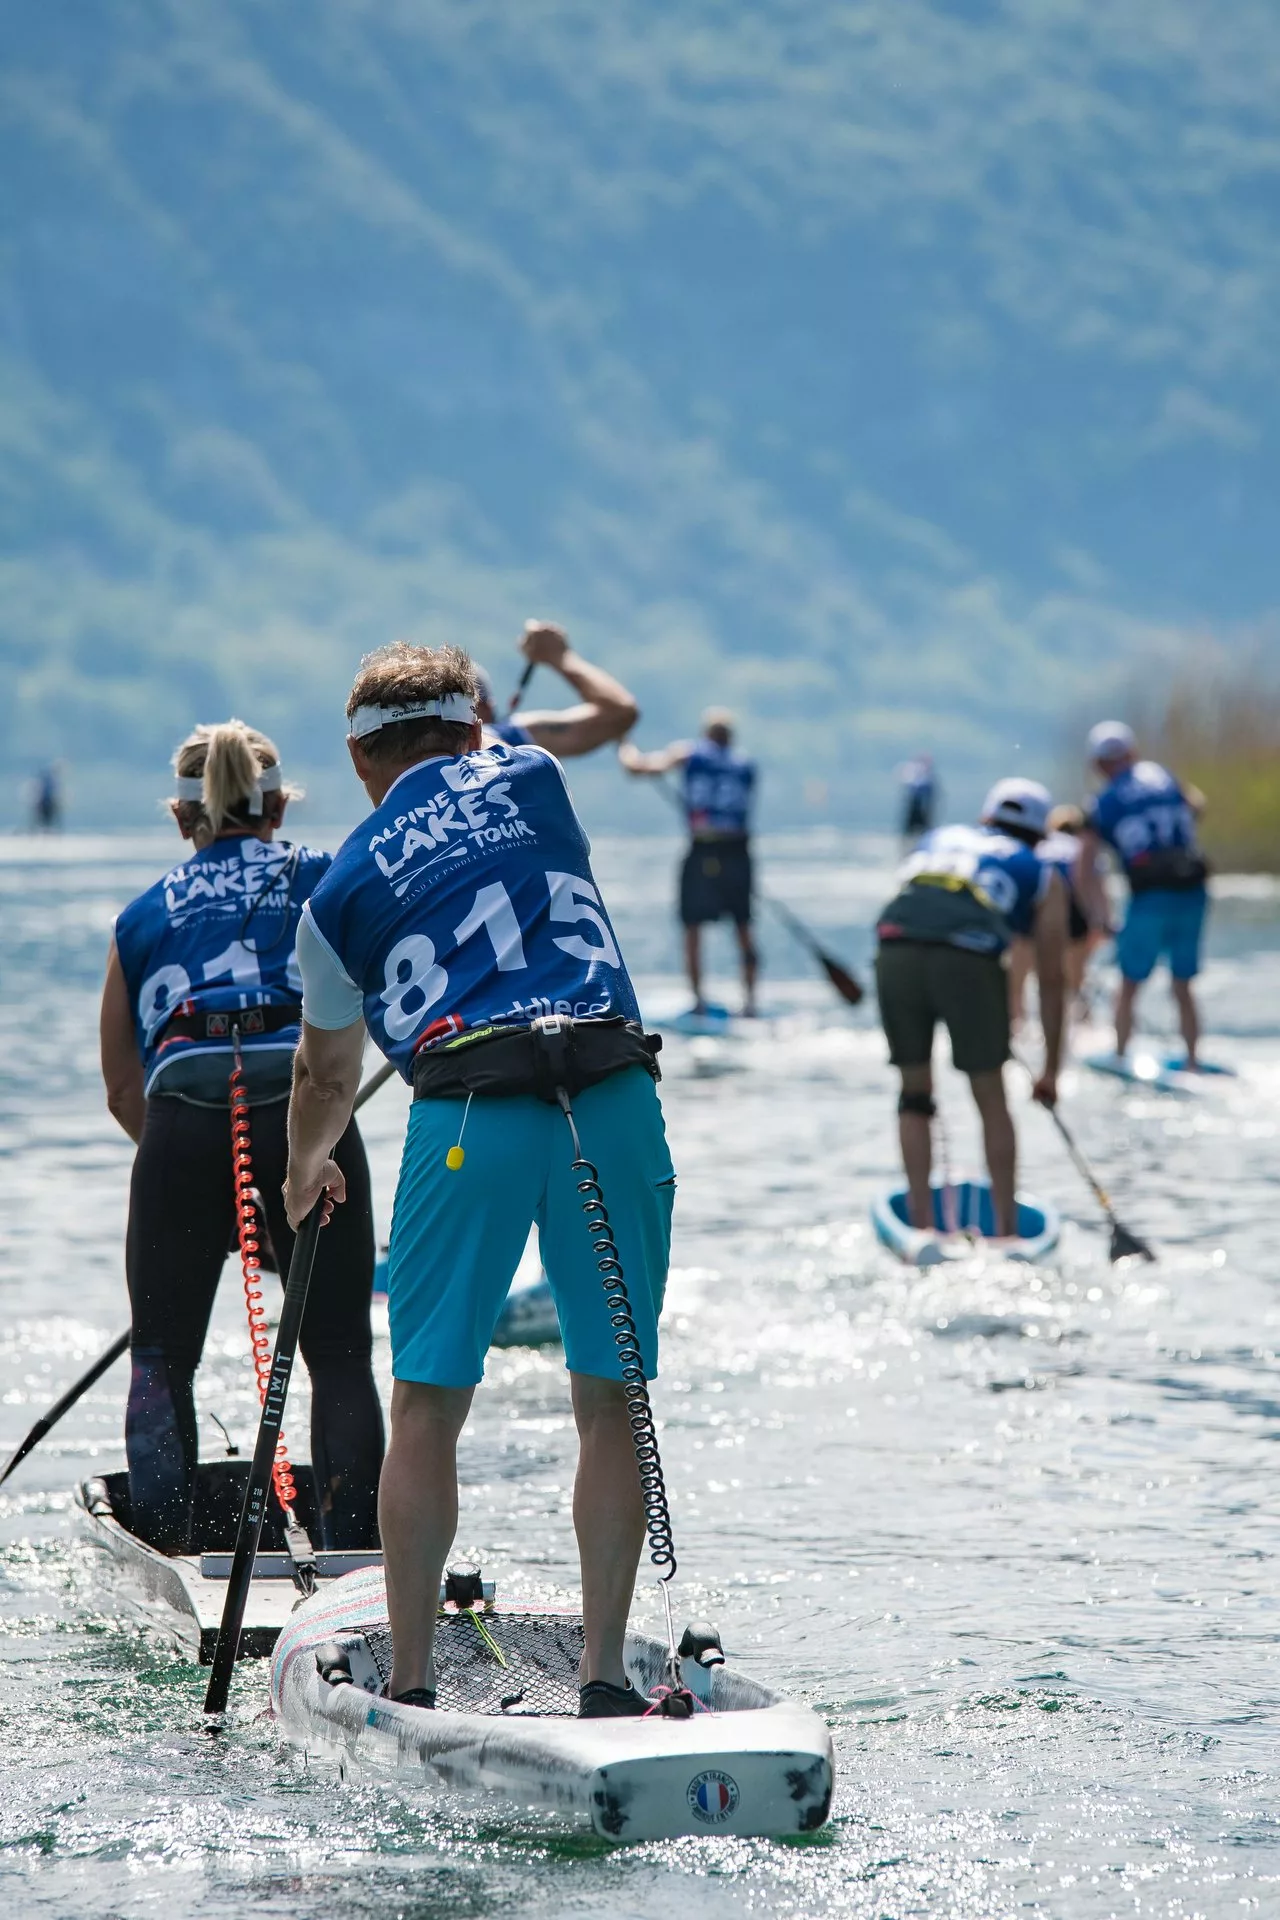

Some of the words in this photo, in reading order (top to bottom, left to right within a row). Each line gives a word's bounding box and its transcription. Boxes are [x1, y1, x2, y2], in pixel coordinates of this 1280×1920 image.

[368, 790, 449, 852] ALPINE
[375, 782, 520, 879] LAKES
[467, 818, 536, 850] TOUR
[482, 839, 539, 856] EXPERIENCE
[163, 857, 241, 889] ALPINE
[165, 863, 291, 912] LAKES
[380, 871, 621, 1041] 815
[263, 1352, 291, 1427] ITIWIT
